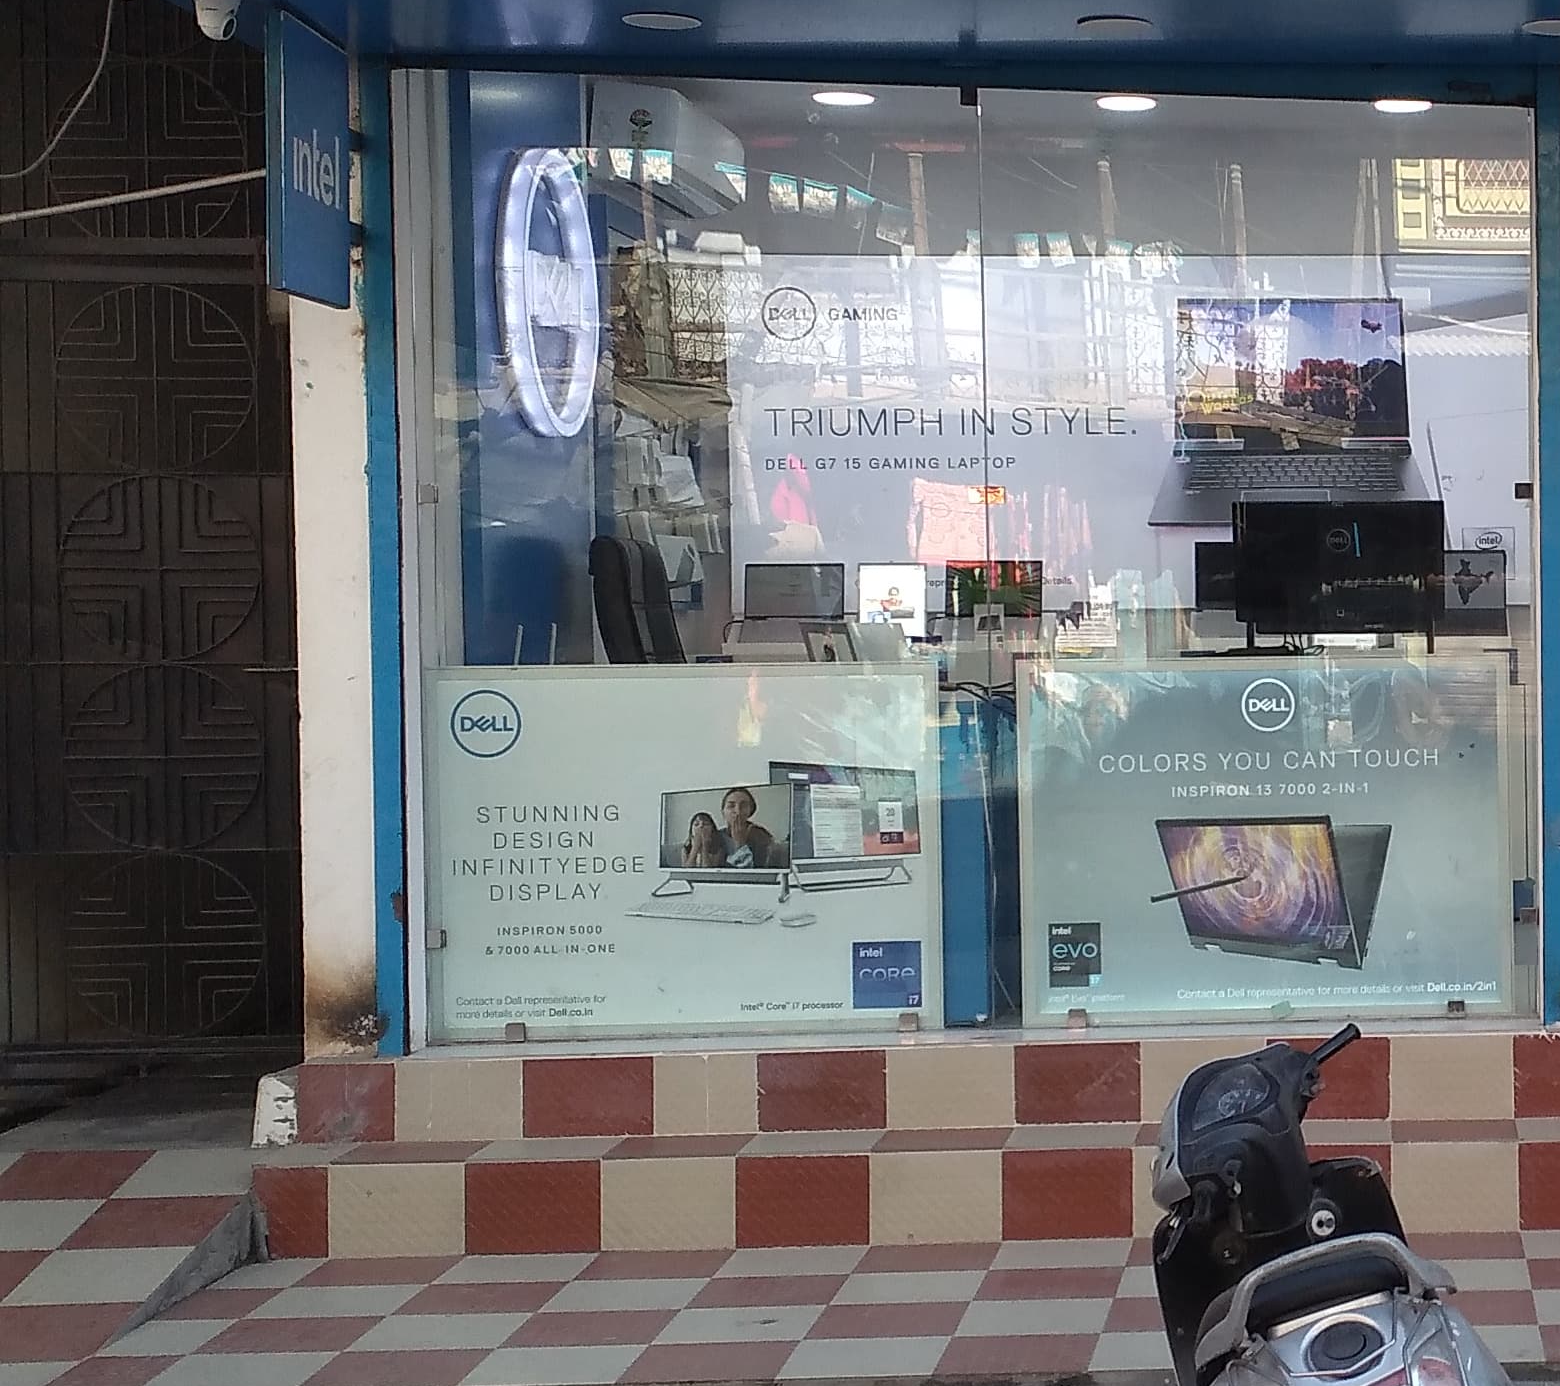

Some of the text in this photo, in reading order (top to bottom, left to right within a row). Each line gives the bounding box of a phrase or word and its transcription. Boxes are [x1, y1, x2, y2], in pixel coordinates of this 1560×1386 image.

[293, 128, 341, 210] intel
[768, 307, 899, 323] DELL GAMING
[764, 407, 1137, 438] TRIUMPH IN STYLE.
[765, 456, 1016, 471] DELL G7 15 GAMING LAPTOP
[1478, 533, 1500, 545] intel
[1248, 698, 1291, 713] DELL
[460, 713, 514, 733] DELL
[1099, 747, 1440, 774] COLORS YOU CAN TOUCH
[1170, 782, 1370, 798] INSPIRON 13 7000 2-IN-1
[476, 804, 620, 824] STUNNING
[493, 830, 594, 850] DESIGN
[451, 855, 645, 877] INFINITYEDGE
[489, 883, 601, 902] DISPLAY
[497, 924, 603, 937] INSPIRON 5000
[1052, 926, 1072, 935] intel
[485, 945, 494, 955] &
[497, 944, 530, 955] 7000
[859, 947, 883, 958] intel
[1052, 942, 1098, 959] evo
[1176, 988, 1217, 1000] Contact
[1218, 990, 1225, 998] a
[1227, 987, 1245, 998] Dell
[1247, 986, 1316, 999] representative
[1317, 984, 1331, 995] for
[1333, 986, 1359, 995] more
[1360, 983, 1390, 994] details
[1392, 984, 1403, 993] or
[1427, 980, 1497, 993] Dell.co.in/2in1
[455, 995, 494, 1006] Contact
[504, 995, 522, 1005] Dell
[524, 995, 591, 1007] representative
[593, 994, 606, 1004] for
[801, 1001, 844, 1012] processor
[908, 995, 920, 1006] i7
[455, 1010, 481, 1019] more
[482, 1008, 513, 1018] details
[514, 1010, 524, 1018] or
[548, 1007, 593, 1017] Dell.co.in
